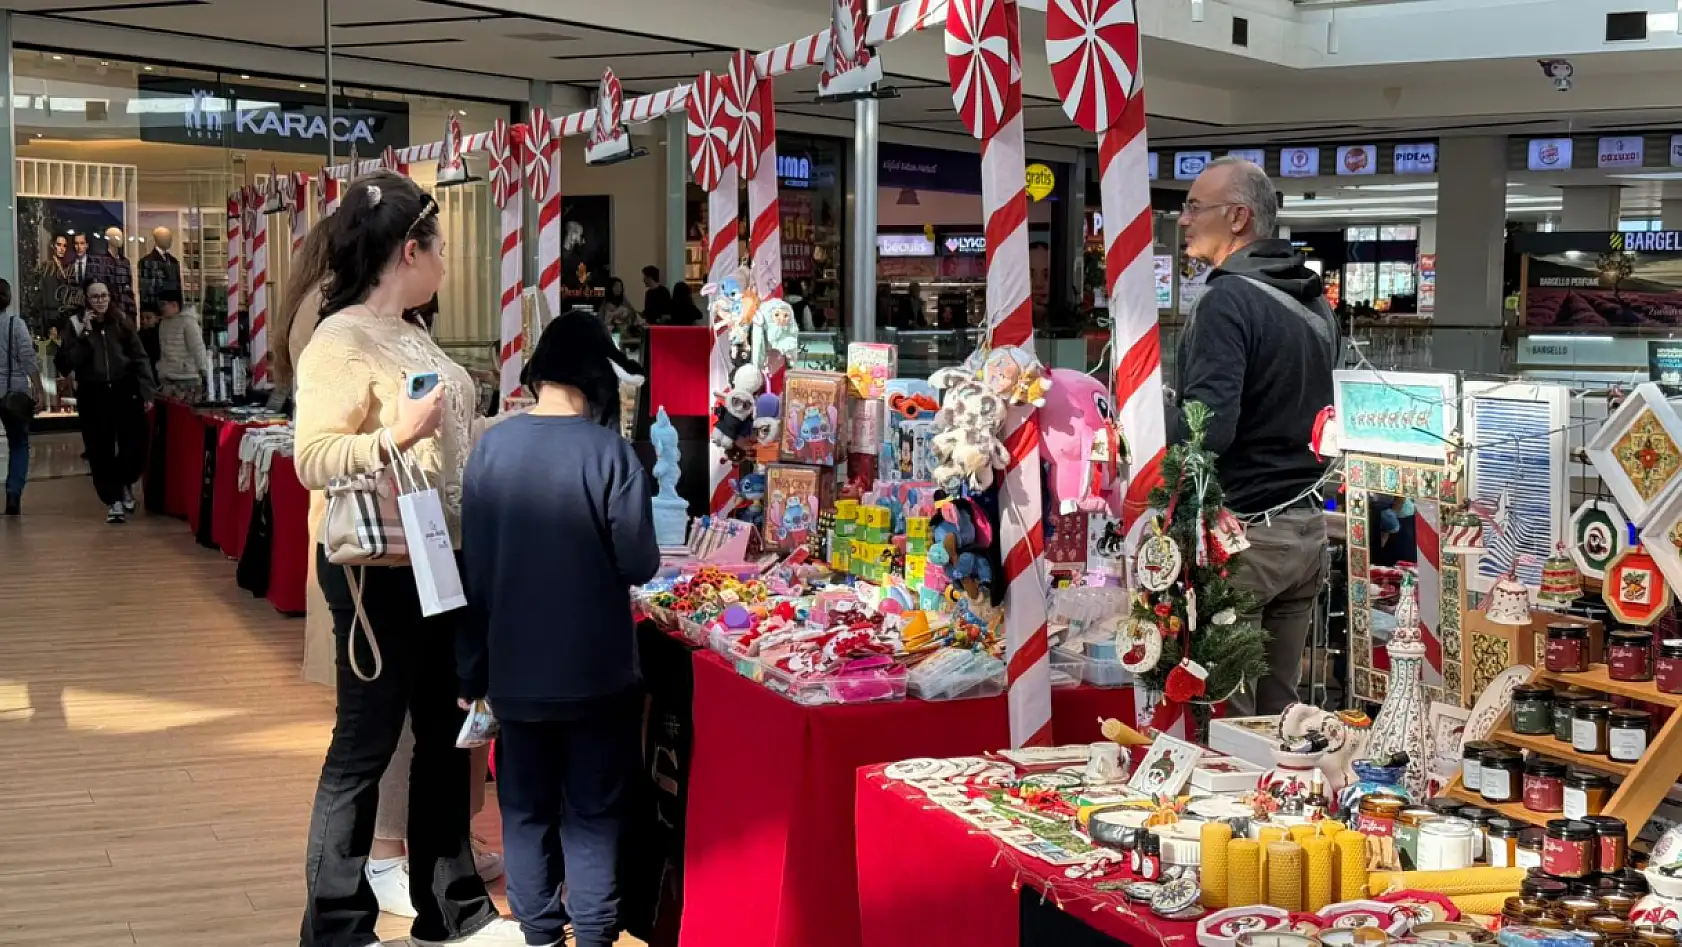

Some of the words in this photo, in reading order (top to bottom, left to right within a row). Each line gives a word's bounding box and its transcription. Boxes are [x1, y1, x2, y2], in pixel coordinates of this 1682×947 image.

[1025, 167, 1052, 187] gratis
[1624, 231, 1682, 250] BARGEL
[1539, 277, 1570, 286] BARGELLO
[1571, 277, 1600, 287] PERFUME
[1532, 345, 1568, 355] BARGELLO
